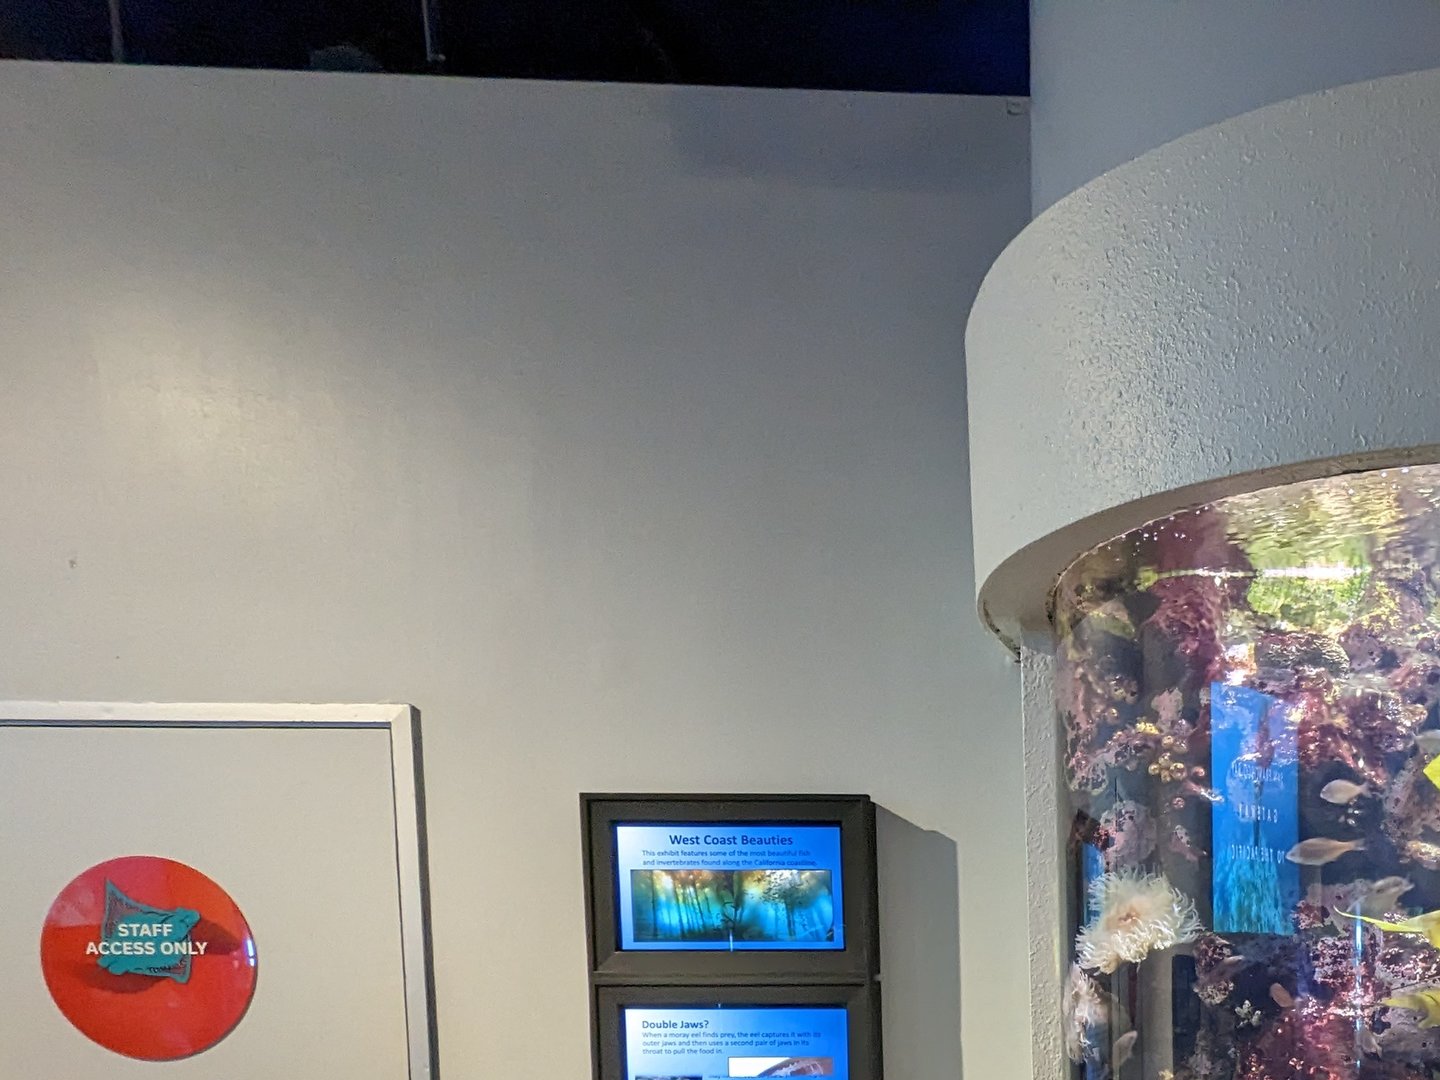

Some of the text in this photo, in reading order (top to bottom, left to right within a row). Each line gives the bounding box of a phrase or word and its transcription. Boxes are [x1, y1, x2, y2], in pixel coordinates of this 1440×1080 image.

[669, 835, 793, 845] West Coast Beauties
[118, 924, 173, 937] STAFF
[86, 942, 208, 955] ACCESS ONLY
[642, 1020, 709, 1028] Double Jaws?
